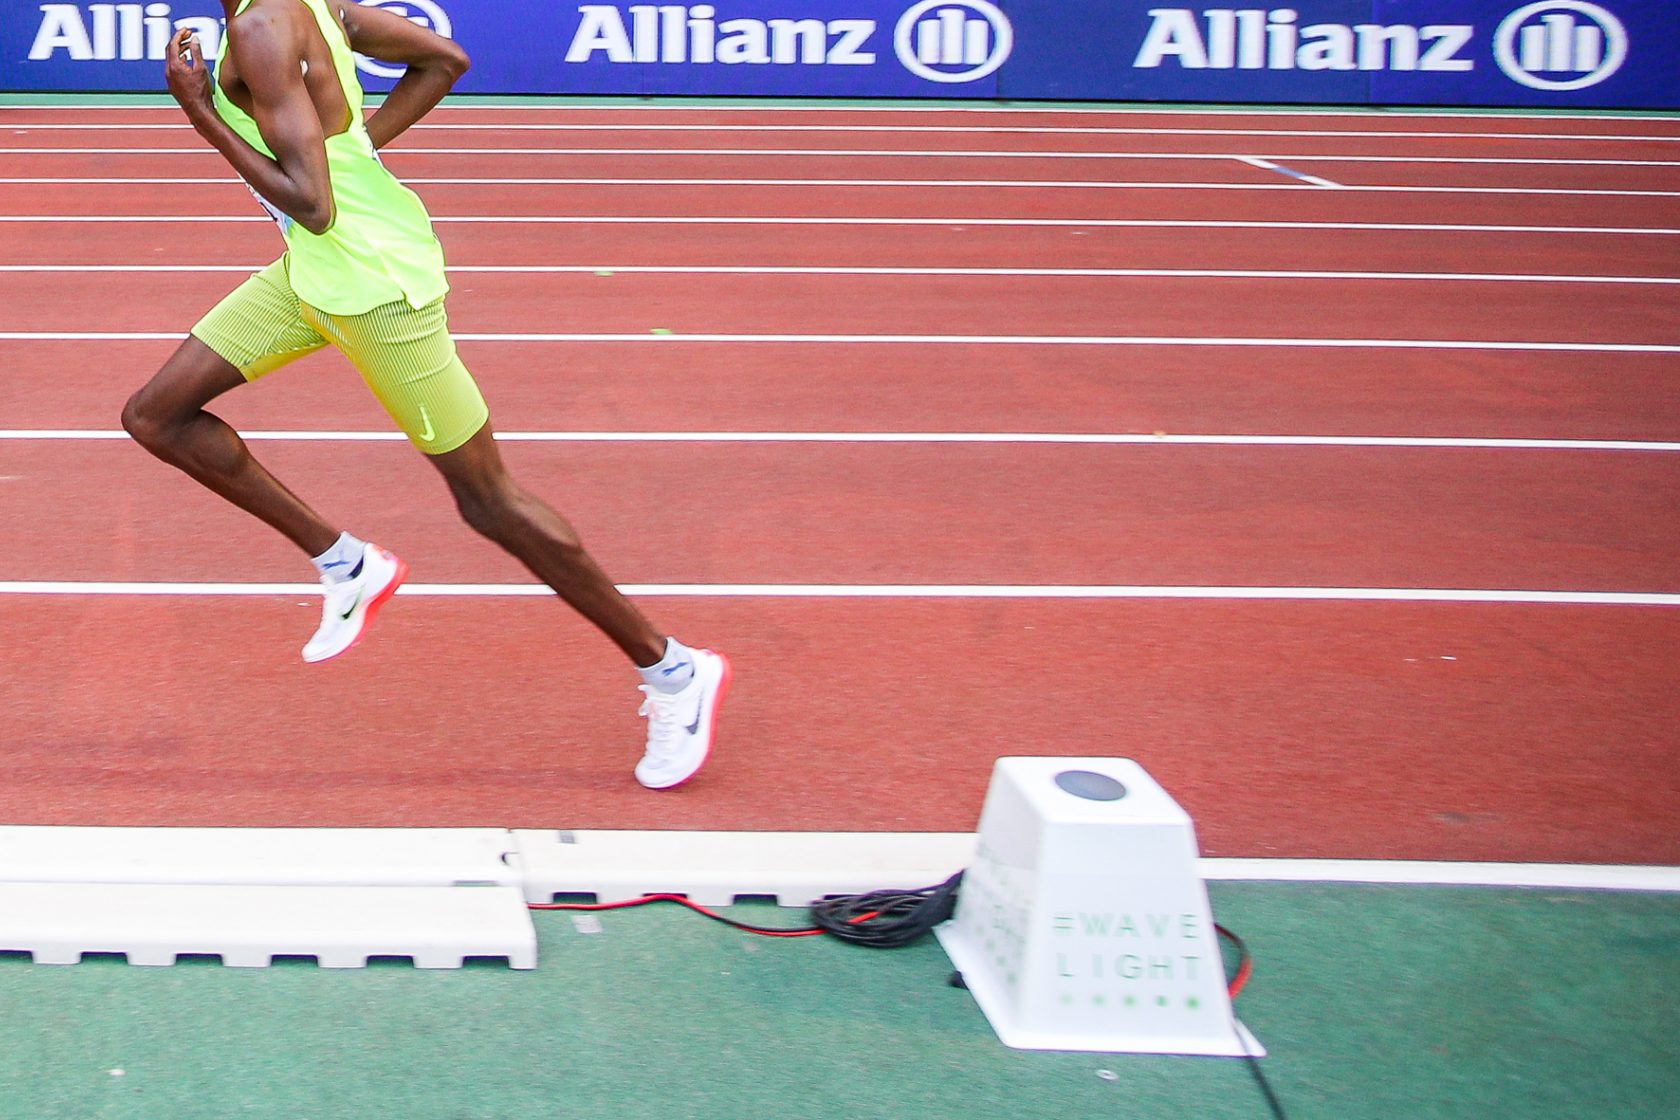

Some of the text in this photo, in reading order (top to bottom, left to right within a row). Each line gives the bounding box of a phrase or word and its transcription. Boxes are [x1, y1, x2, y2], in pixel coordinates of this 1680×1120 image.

[28, 3, 226, 60] Allia
[565, 5, 876, 65] Allianz
[1133, 9, 1474, 71] Allianz
[1056, 953, 1202, 980] LIGHT
